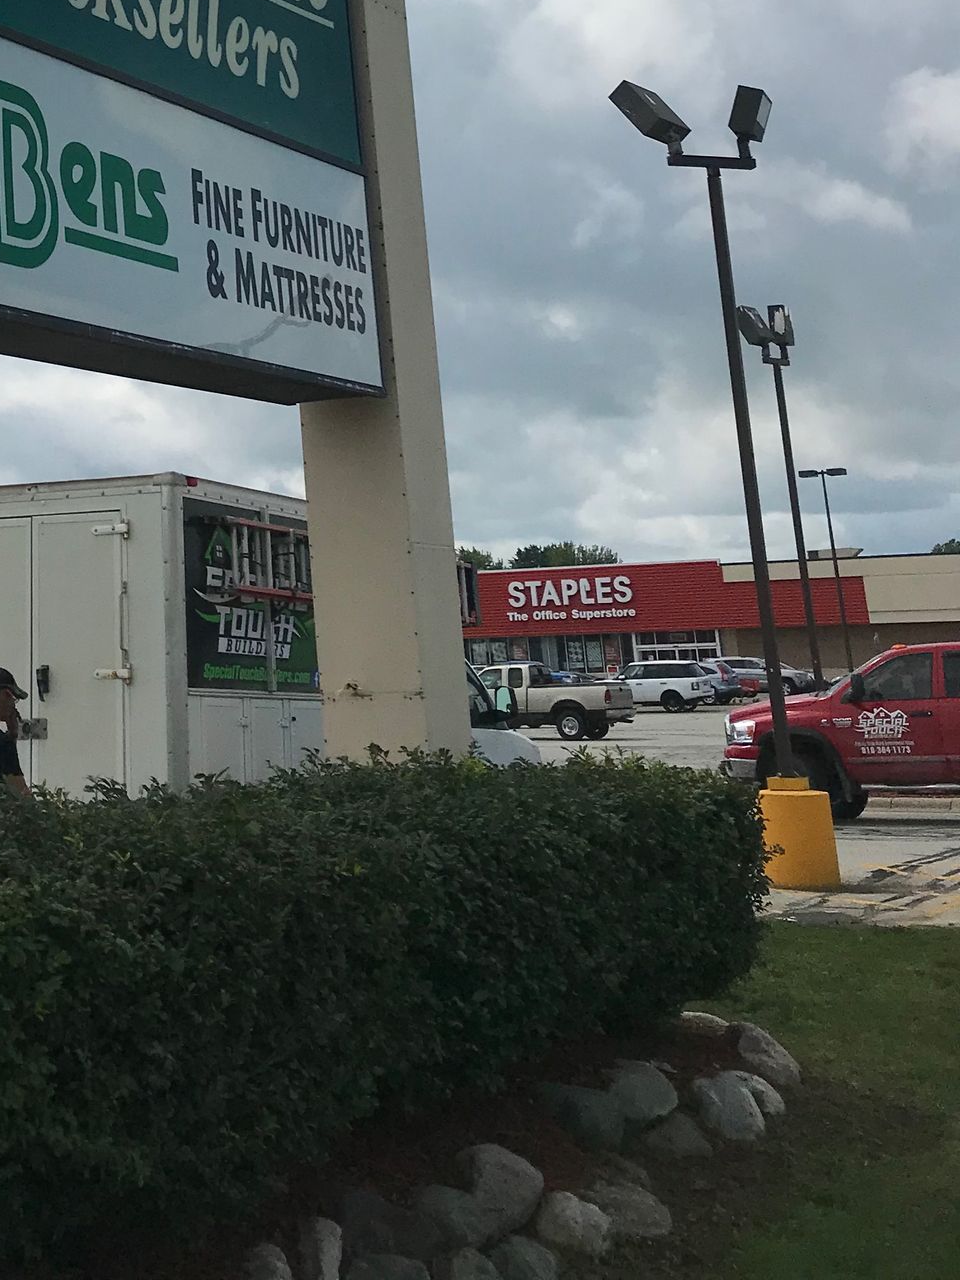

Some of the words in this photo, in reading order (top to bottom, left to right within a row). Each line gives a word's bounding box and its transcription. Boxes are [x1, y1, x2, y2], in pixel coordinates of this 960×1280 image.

[191, 168, 245, 238] FINE
[251, 187, 367, 274] FURNITURE
[206, 239, 228, 300] &
[235, 248, 366, 335] MATTRESSES
[507, 576, 633, 608] STAPLES
[507, 612, 529, 622] The
[533, 610, 567, 620] Office
[571, 607, 637, 621] Superstore
[226, 639, 284, 657] BUILDRS
